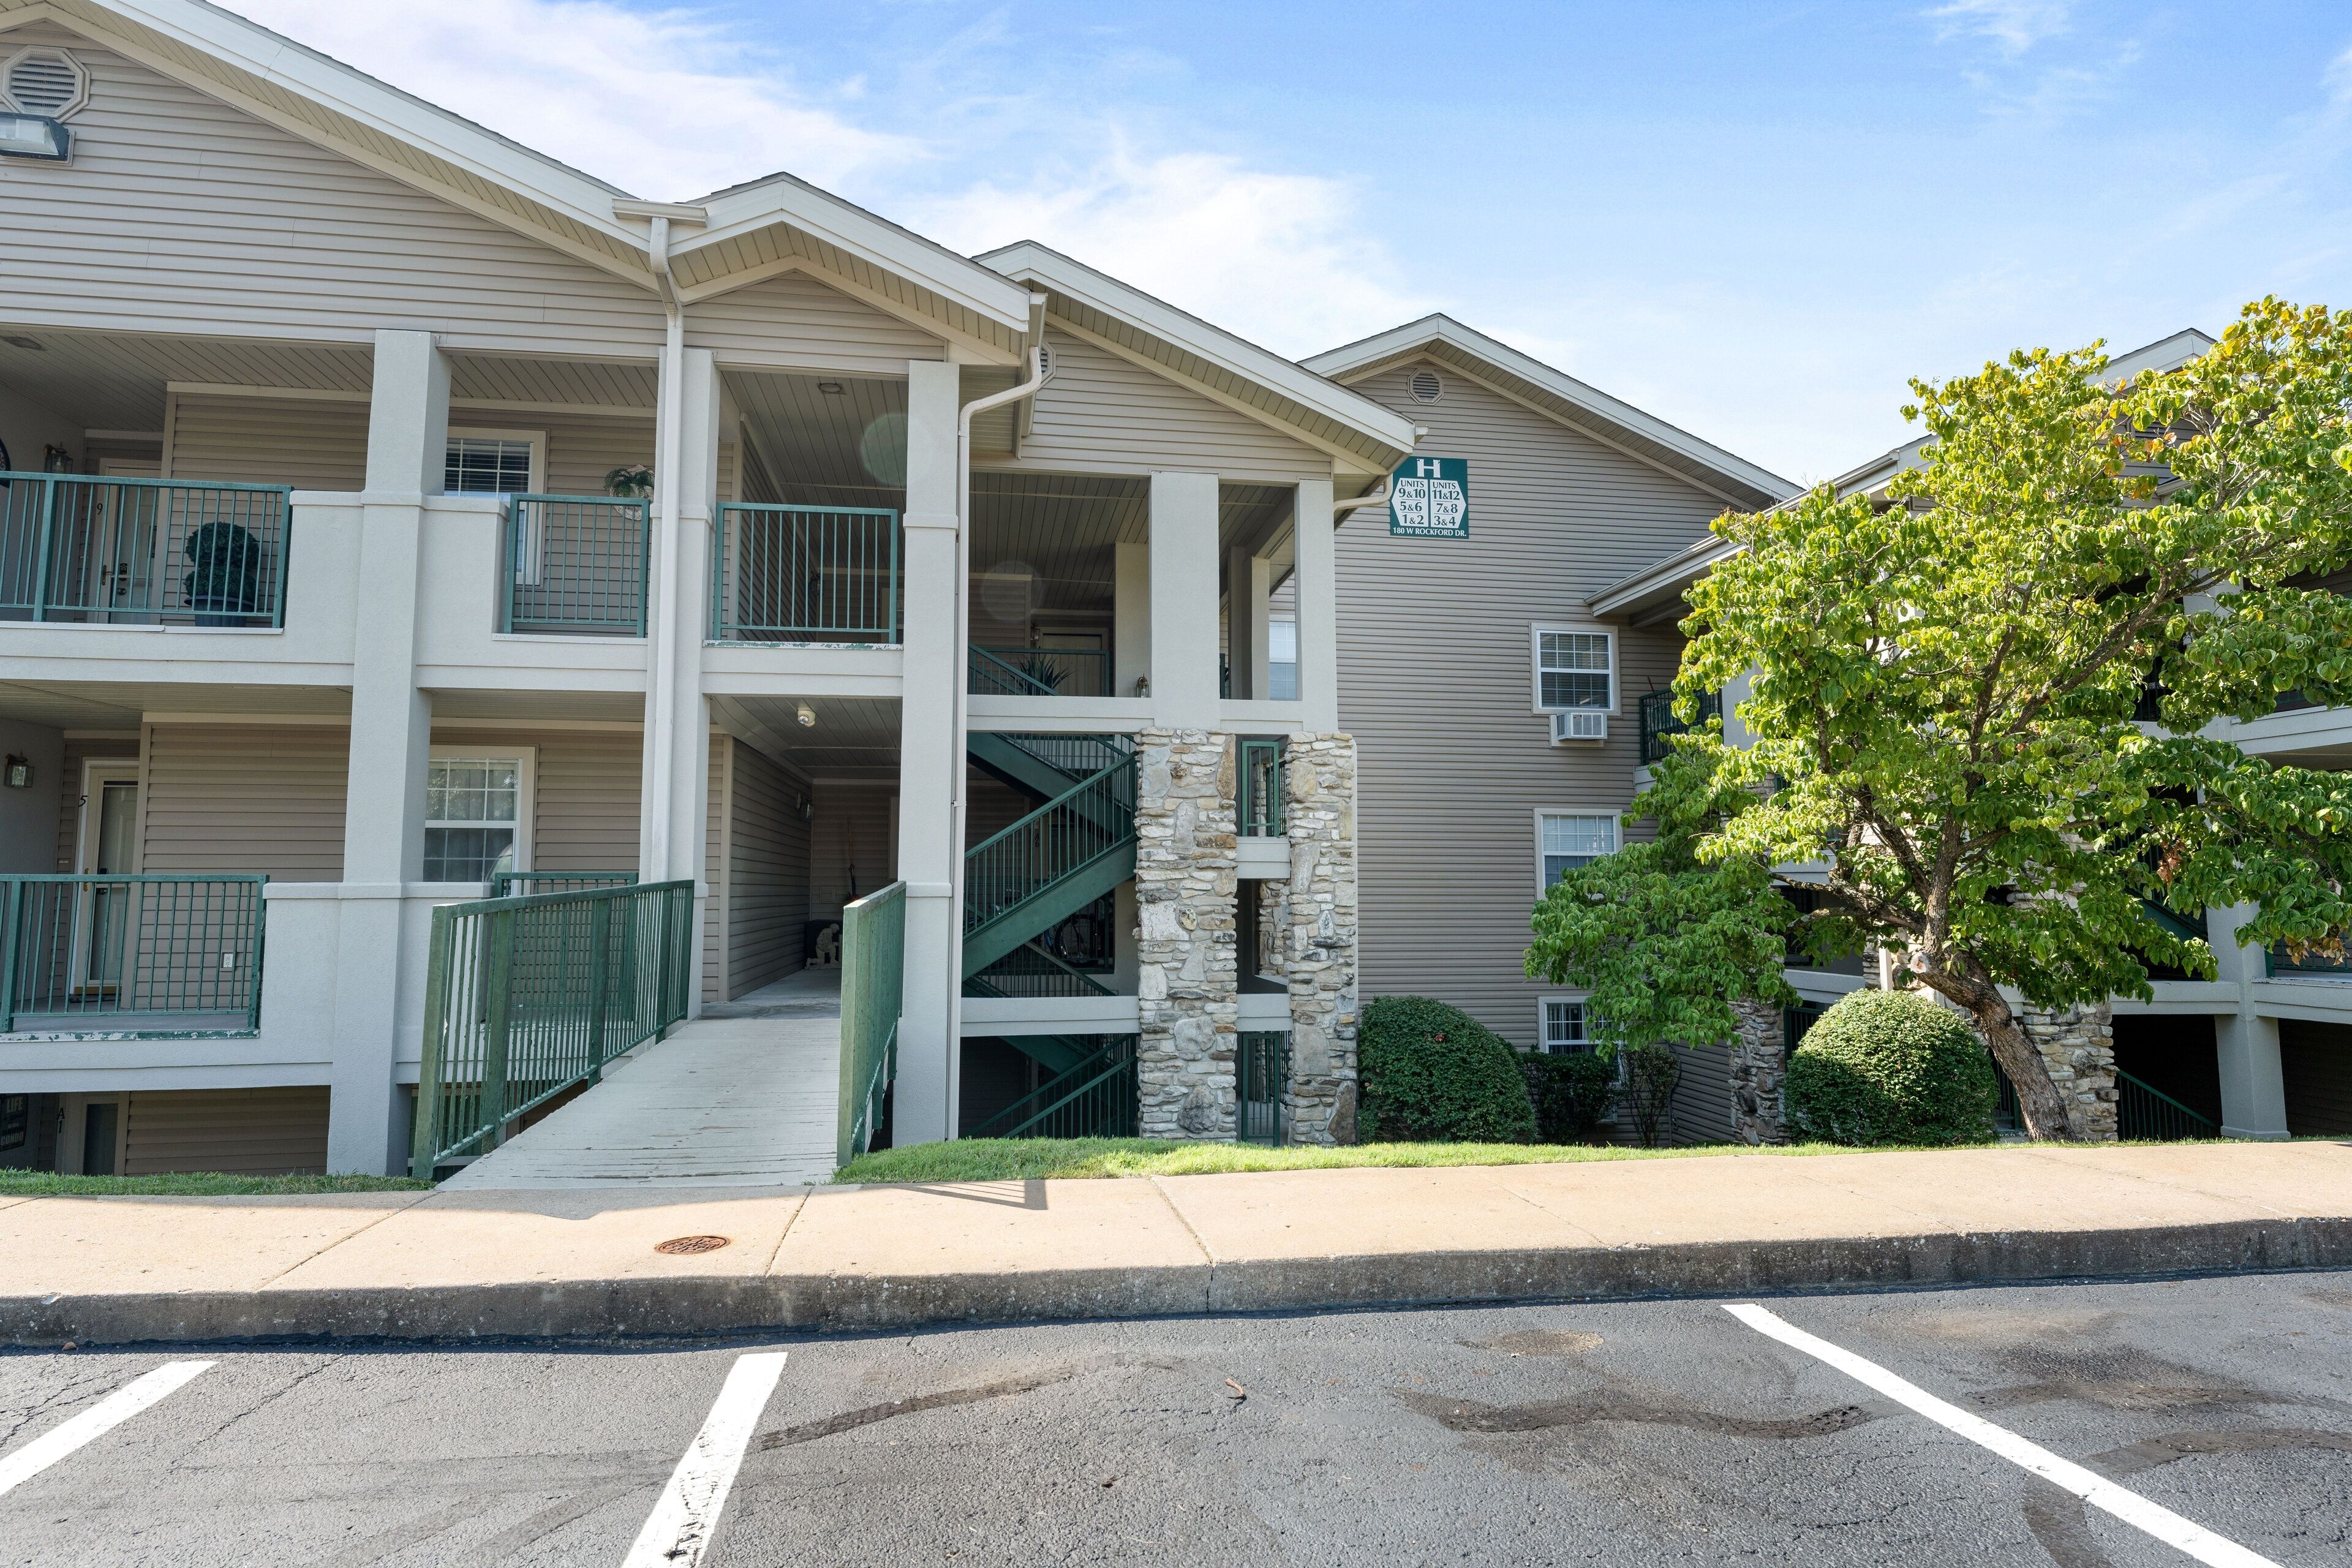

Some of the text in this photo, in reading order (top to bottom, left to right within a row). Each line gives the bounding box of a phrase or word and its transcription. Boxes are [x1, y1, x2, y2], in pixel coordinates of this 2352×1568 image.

[1417, 459, 1441, 478] H
[1398, 488, 1426, 499] 9&10
[1431, 489, 1460, 500] 11&12
[97, 503, 103, 515] 9
[83, 795, 88, 807] 5
[6, 1097, 23, 1114] LIFE
[1, 1131, 24, 1145] CONDO
